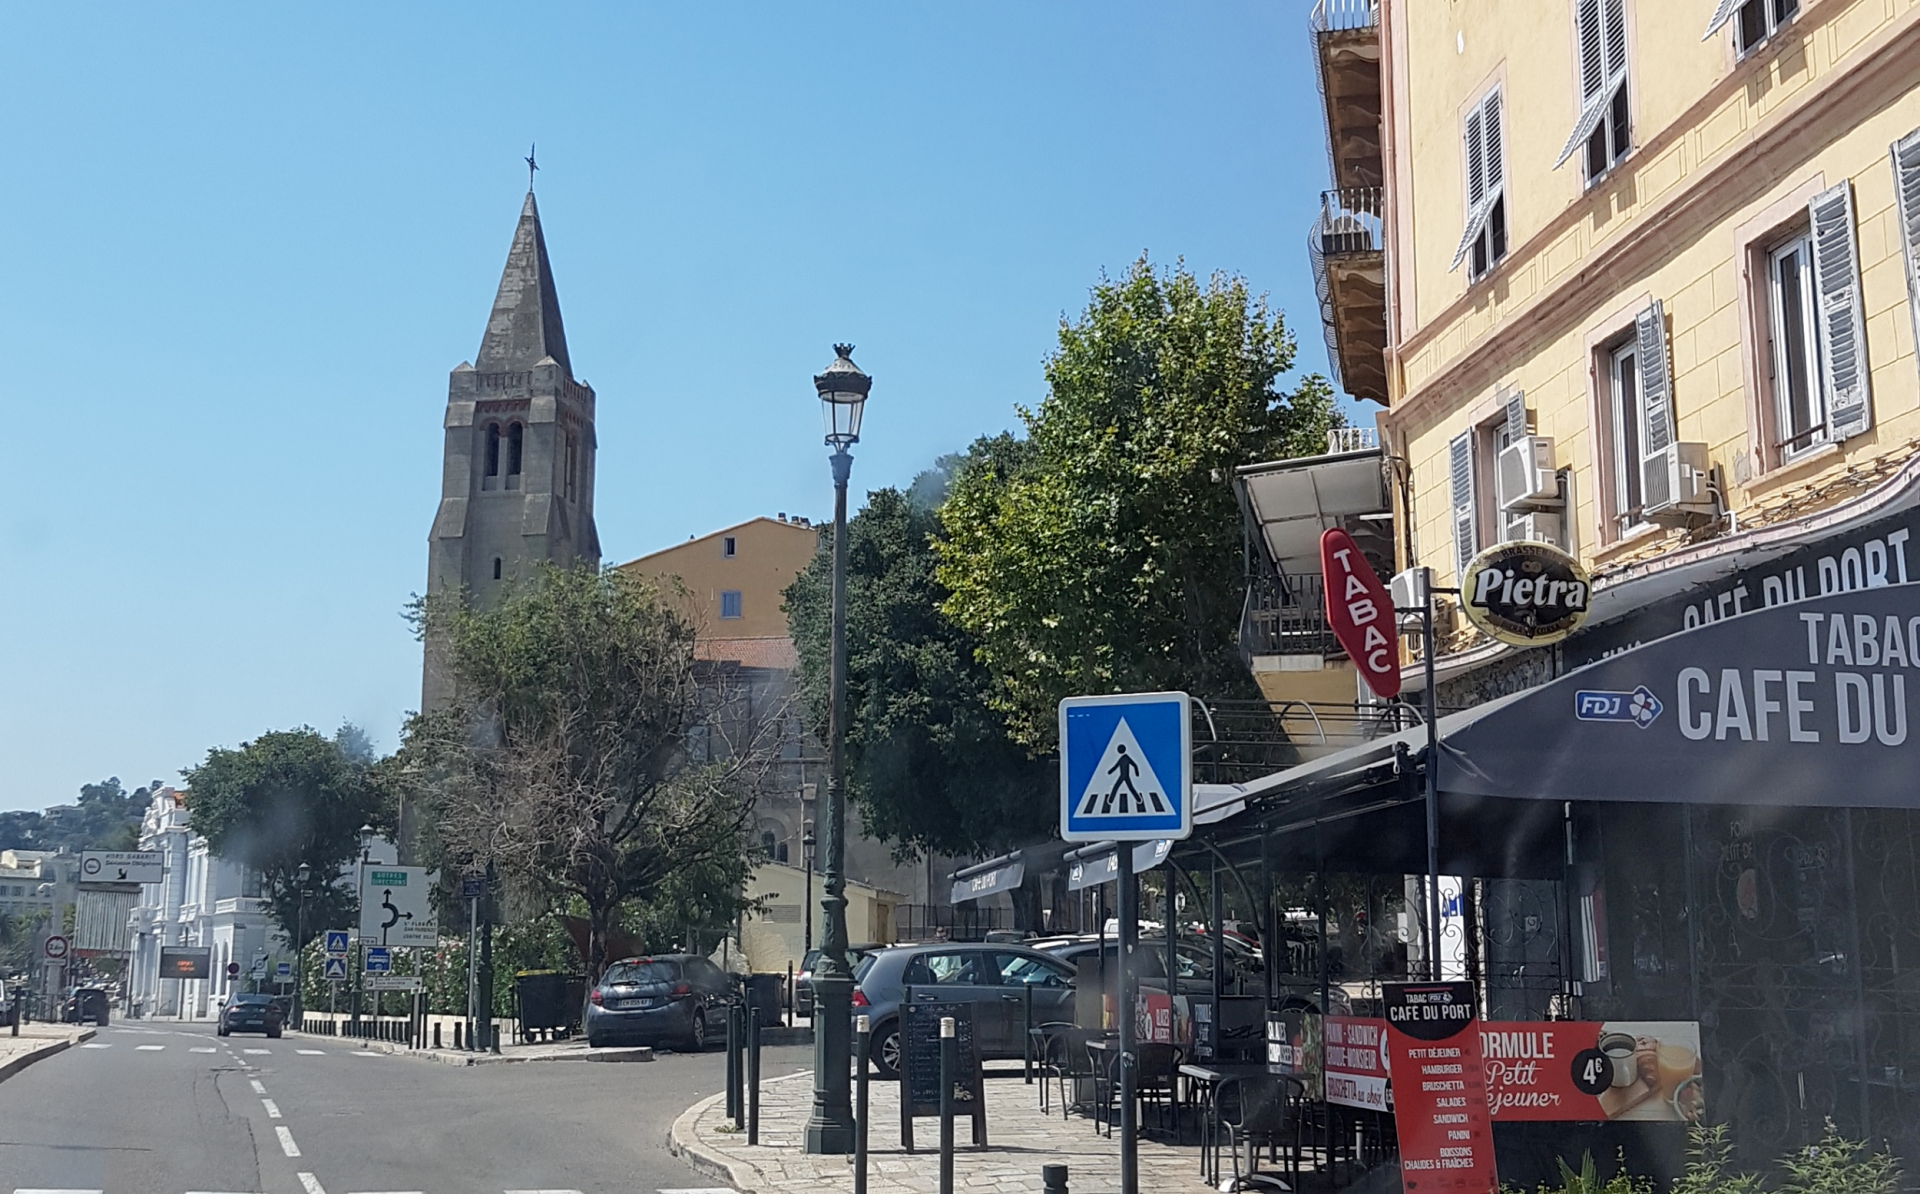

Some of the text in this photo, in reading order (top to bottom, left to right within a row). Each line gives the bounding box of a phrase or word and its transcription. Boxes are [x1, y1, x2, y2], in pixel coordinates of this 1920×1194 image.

[1473, 568, 1586, 608] Pietra
[1333, 548, 1392, 673] TABAC
[1581, 696, 1621, 715] FDJ
[1677, 667, 1908, 746] CAFE DU
[1405, 994, 1427, 1003] TABAC
[1422, 1005, 1438, 1020] DU
[1441, 1004, 1471, 1019] PORT
[1347, 1024, 1378, 1047] SANDWICH
[1408, 1048, 1427, 1059] PETIT
[1427, 1046, 1461, 1058] DÉJEUNER
[1479, 1032, 1555, 1059] ORMULE
[1421, 1063, 1463, 1075] HAMBURGER
[1485, 1060, 1544, 1086] Petit
[1583, 1057, 1603, 1085] 4€
[1422, 1080, 1465, 1091] BRUSCHETTA
[1436, 1097, 1466, 1108] SALADES
[1486, 1085, 1562, 1115] éjeuner
[1433, 1113, 1468, 1124] SANDWICH
[1447, 1130, 1470, 1140] PANINI
[1440, 1146, 1472, 1157] BOISSONS
[1404, 1159, 1434, 1170] CHAUDES
[1435, 1160, 1441, 1169] &
